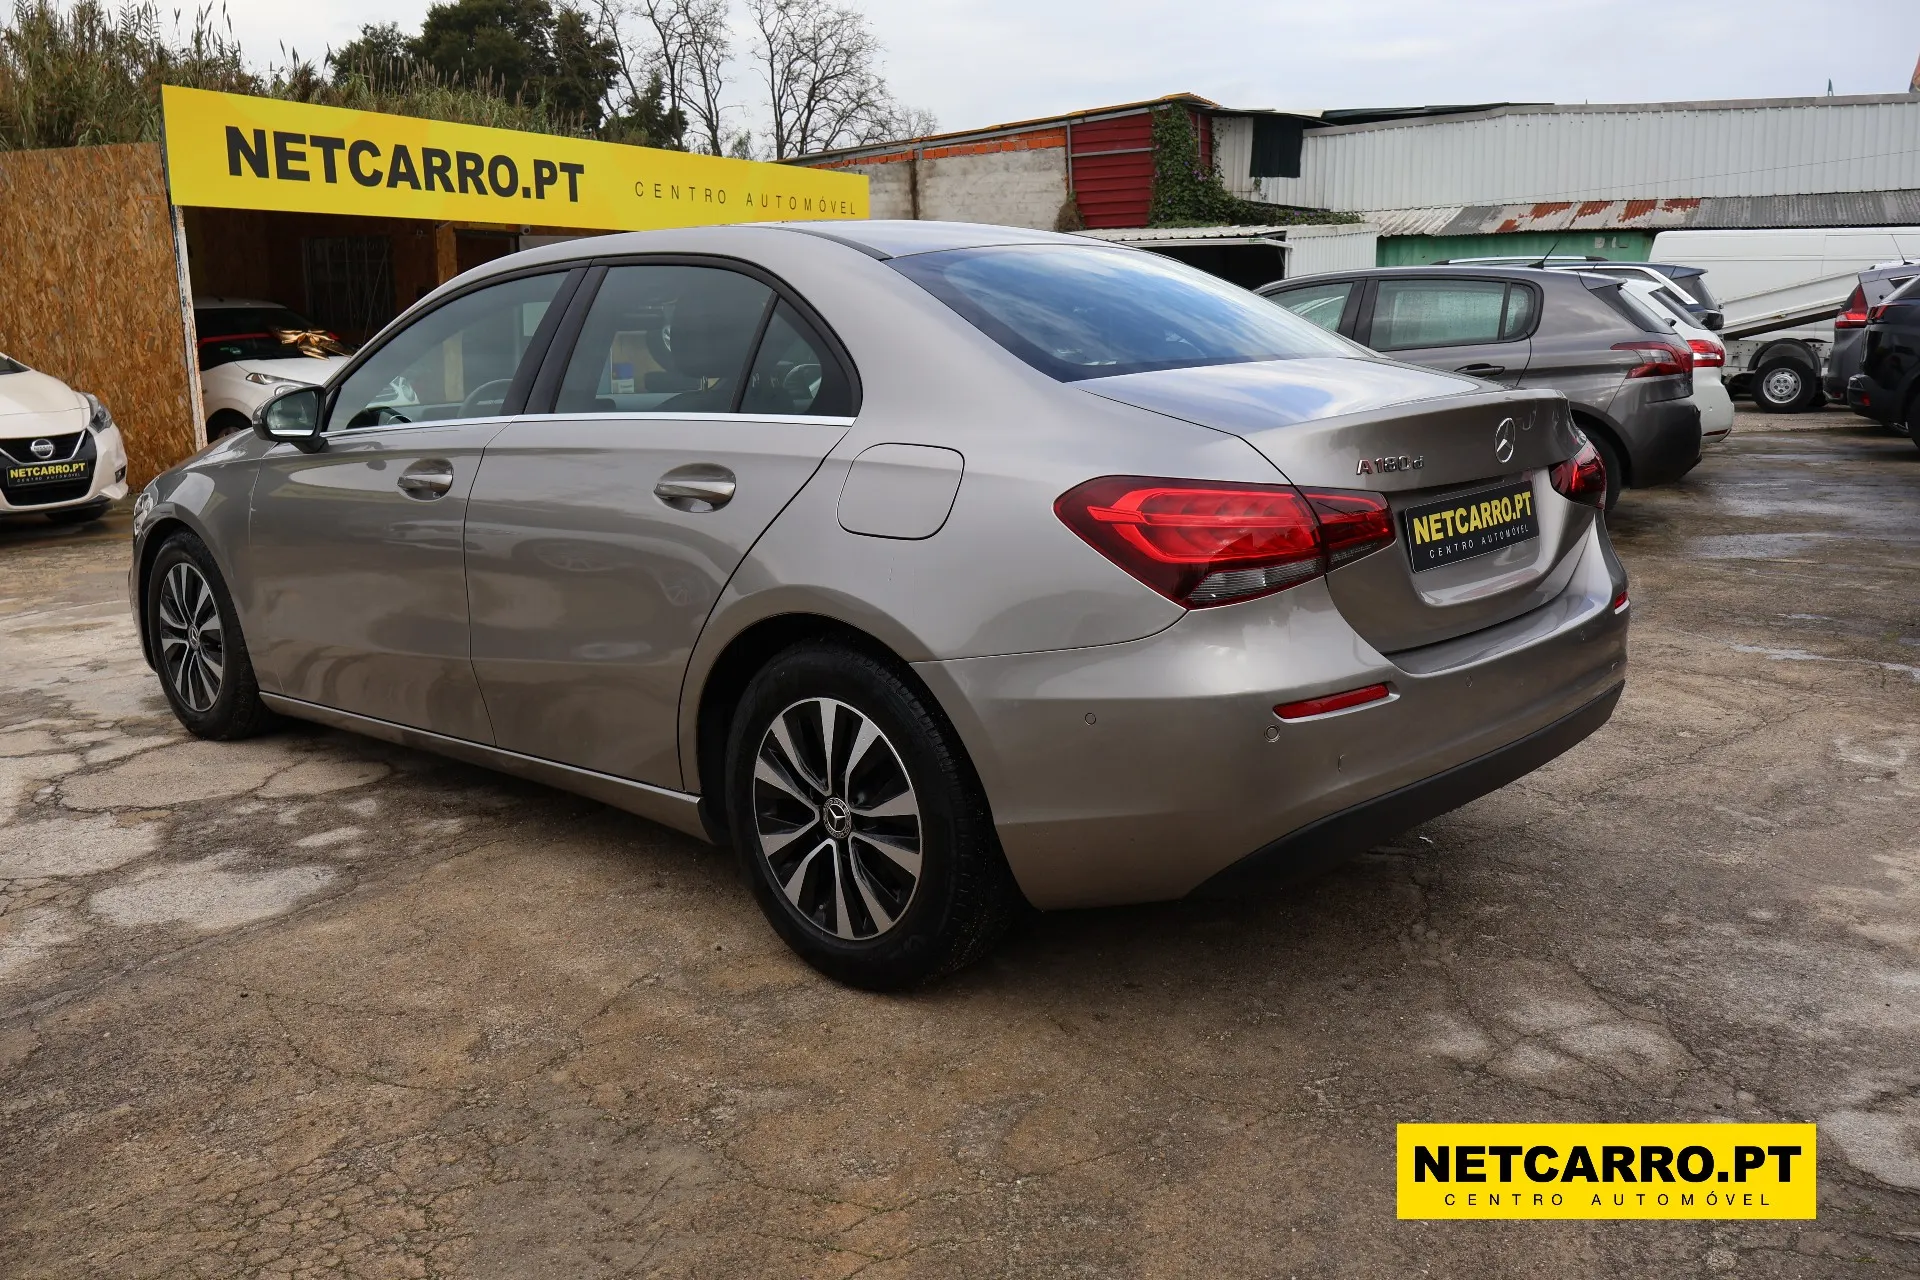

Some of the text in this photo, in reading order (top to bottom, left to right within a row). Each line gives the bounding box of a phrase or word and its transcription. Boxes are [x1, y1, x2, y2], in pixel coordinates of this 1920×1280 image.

[225, 125, 585, 203] NETCARRO.PT
[635, 181, 856, 215] CENTRO AUTOMÓVEL
[10, 462, 85, 478] NETCARRO.PT
[1413, 490, 1532, 545] NETCARRO.PT
[1429, 523, 1529, 559] CENTRO AUTOMÓVEL
